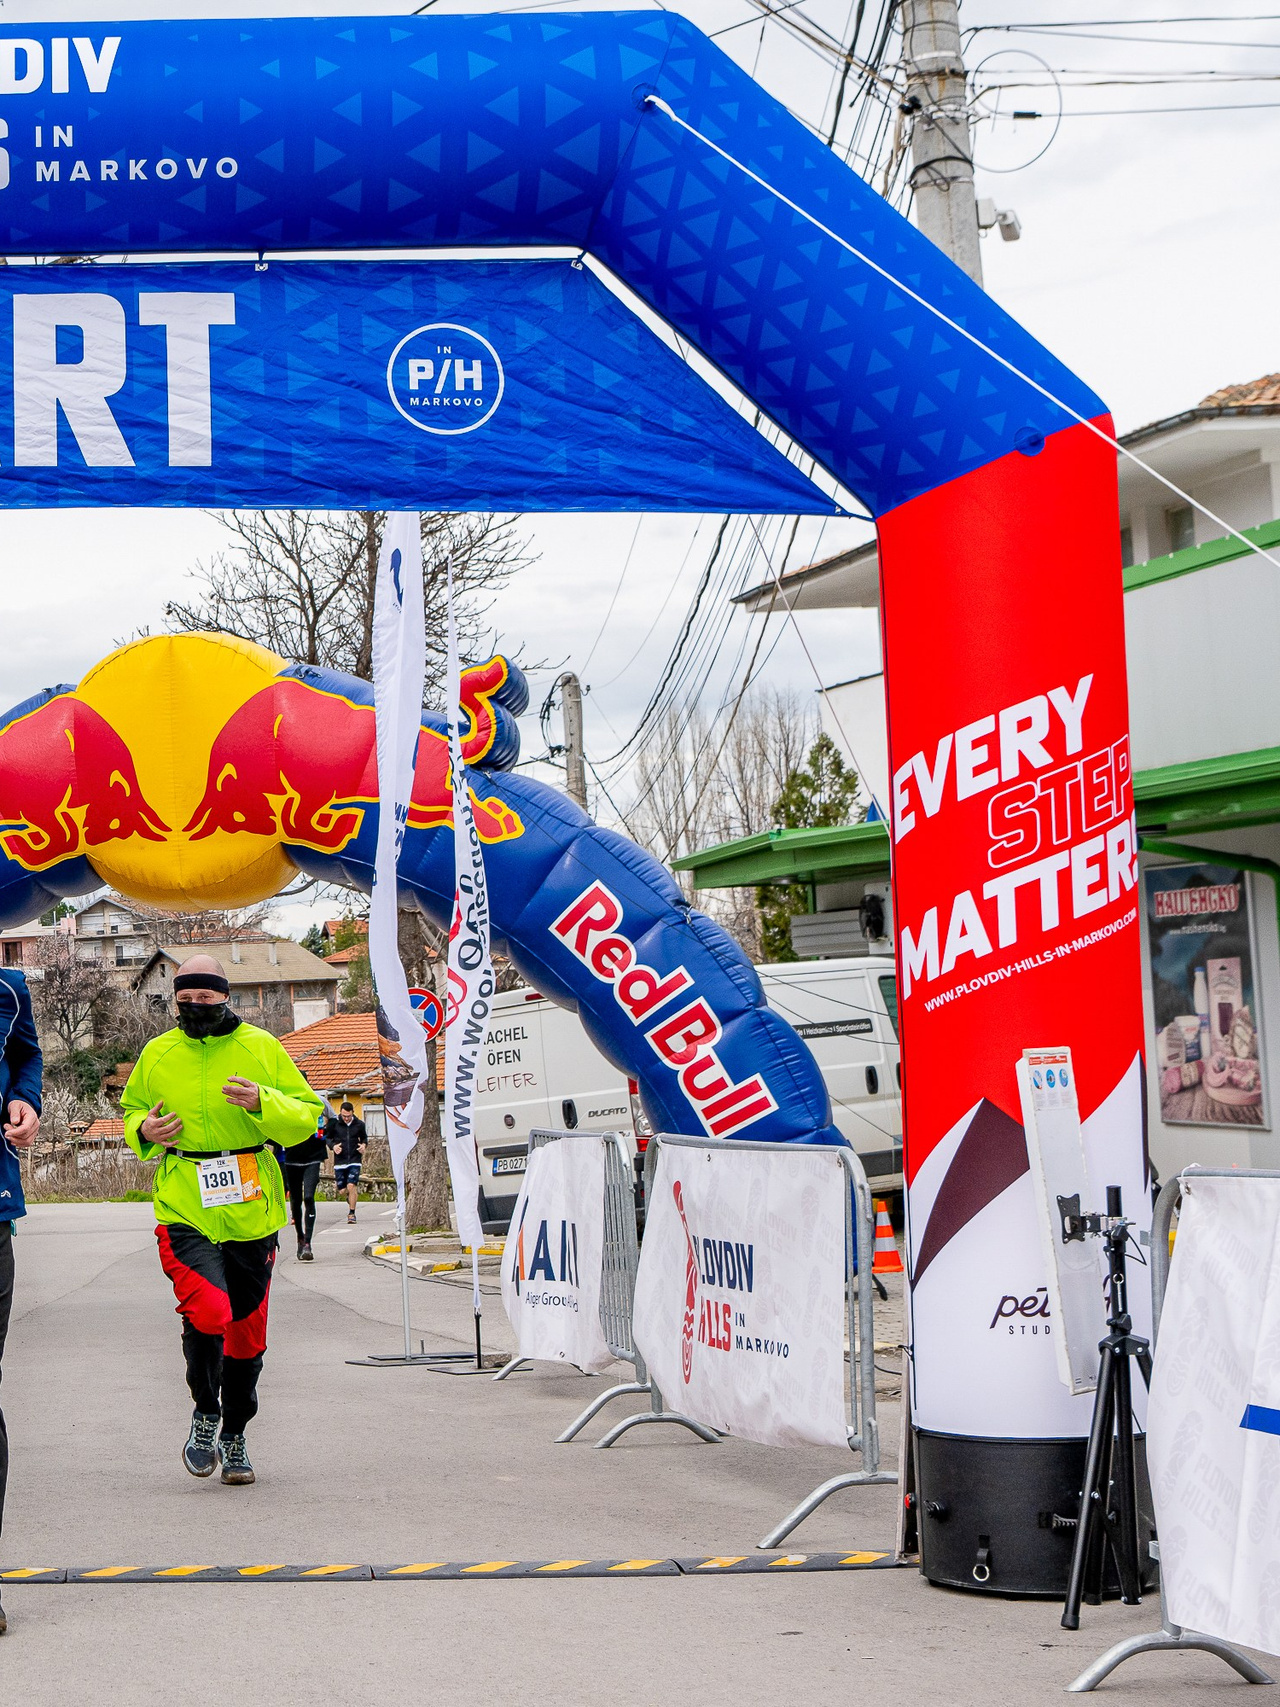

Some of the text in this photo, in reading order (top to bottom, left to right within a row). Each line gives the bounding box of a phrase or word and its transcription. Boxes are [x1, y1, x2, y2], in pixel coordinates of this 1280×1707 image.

[35, 125, 74, 148] IN
[35, 157, 238, 182] MARKOVO
[436, 345, 452, 354] IN
[408, 359, 483, 394] P/H
[409, 397, 484, 407] MARKOVO
[893, 673, 1094, 845] EVERY
[987, 733, 1132, 869] STEP
[1154, 883, 1241, 918] НАШЕНСКО
[924, 907, 1137, 1012] WWW.PLOVDIV-HILLS-IN-MARKOVO.COM
[551, 882, 775, 1137] Red Bull
[483, 1026, 528, 1046] ACHEL
[487, 1048, 521, 1066] ÖFEN
[476, 1072, 537, 1093] LEITER
[587, 1107, 628, 1118] DUCATO
[202, 1170, 235, 1189] 1381
[735, 1312, 746, 1328] IN
[1008, 1325, 1051, 1335] STUD
[735, 1335, 790, 1359] MARKOVO
